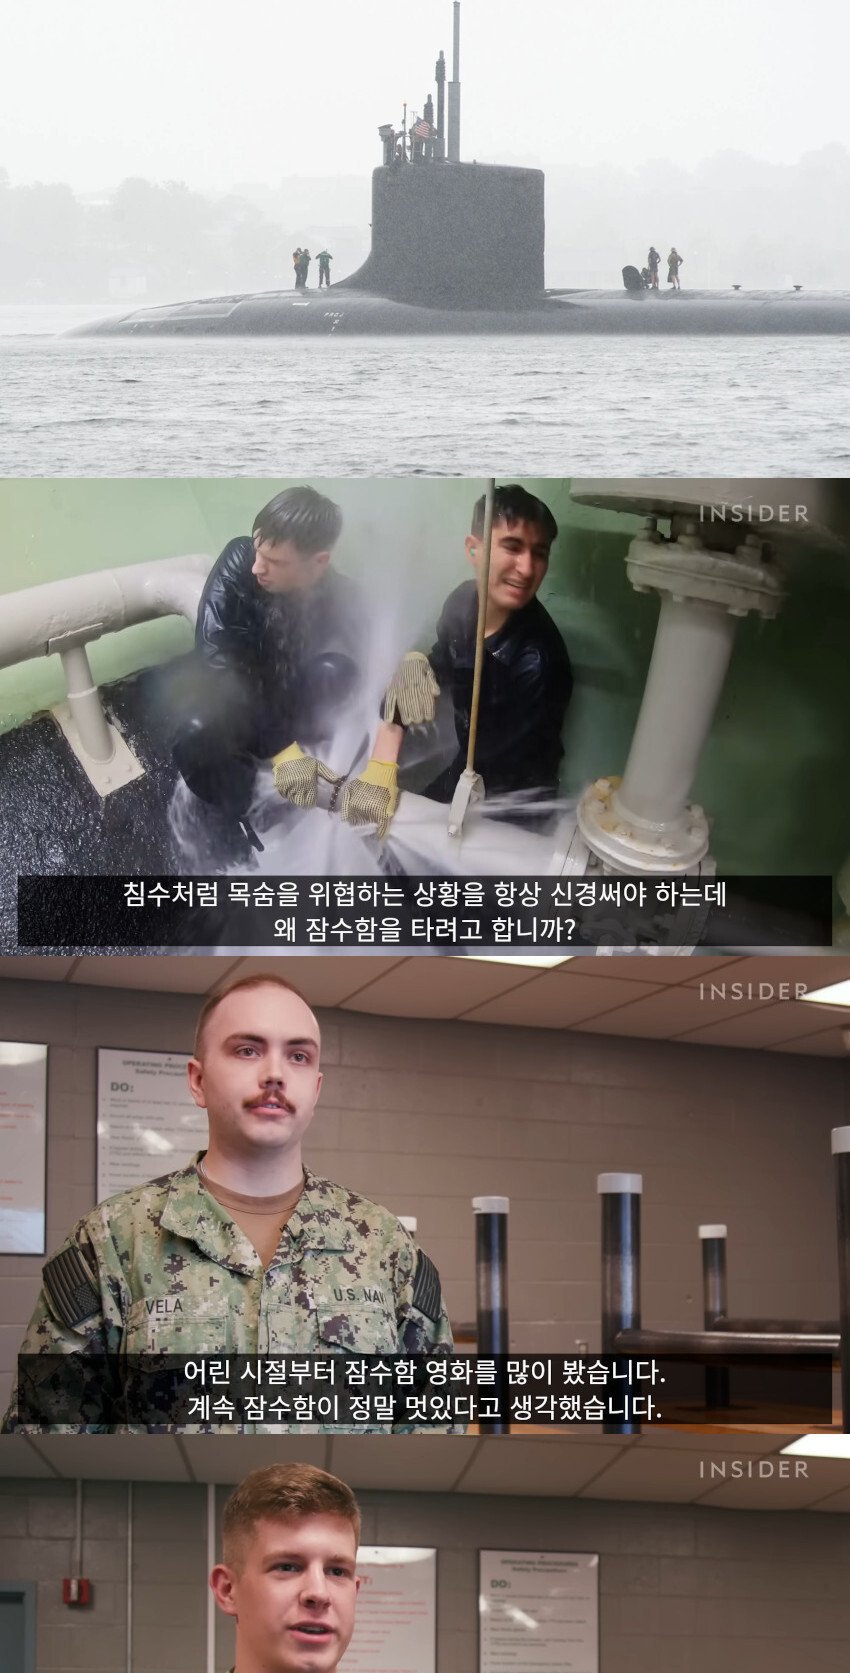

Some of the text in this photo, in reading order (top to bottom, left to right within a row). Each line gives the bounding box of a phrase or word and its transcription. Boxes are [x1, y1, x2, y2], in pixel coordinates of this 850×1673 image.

[110, 1082, 134, 1093] DO:
[333, 1288, 384, 1304] U.S. NAV
[146, 1299, 183, 1315] VELA
